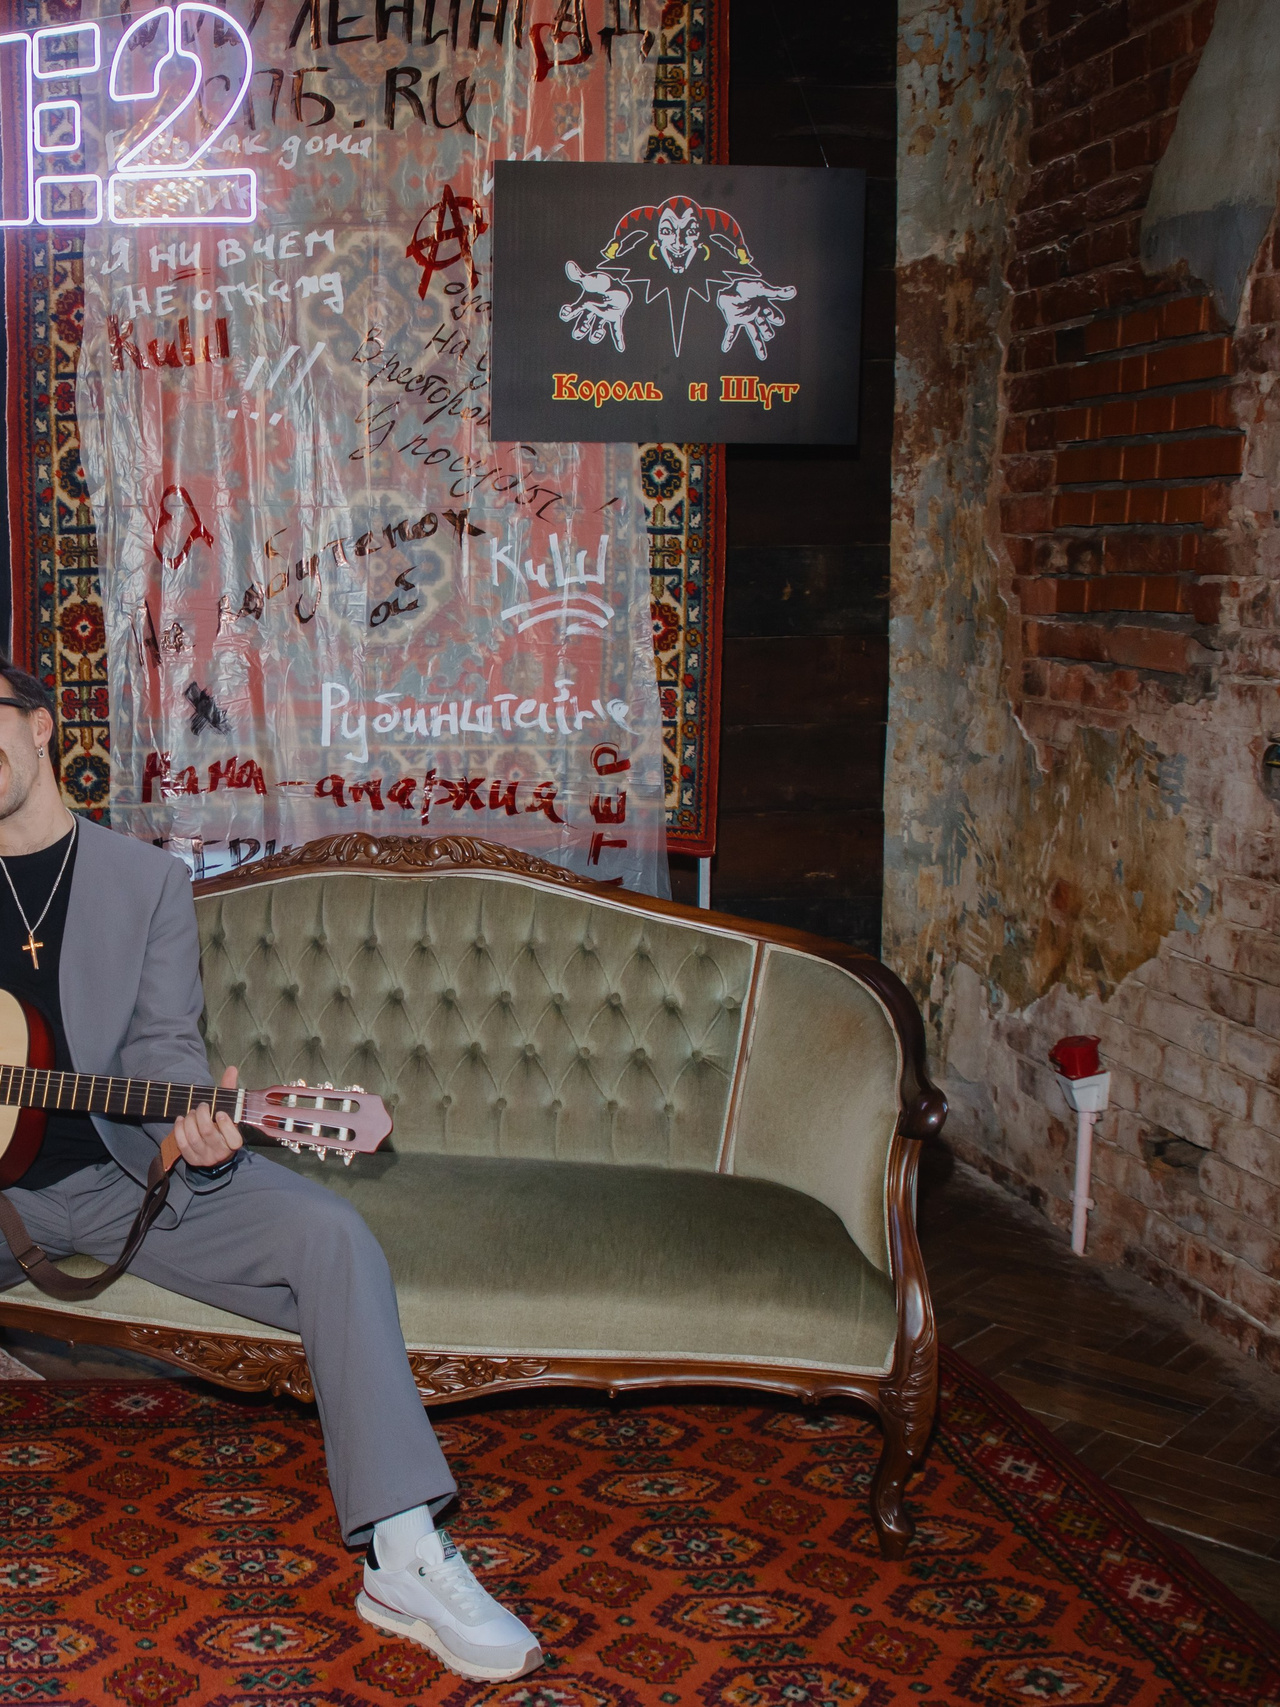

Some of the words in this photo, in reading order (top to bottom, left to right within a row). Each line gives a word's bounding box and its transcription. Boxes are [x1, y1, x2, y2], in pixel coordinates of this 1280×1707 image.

[551, 373, 664, 408] Король
[688, 380, 708, 402] и
[719, 375, 801, 411] Шут
